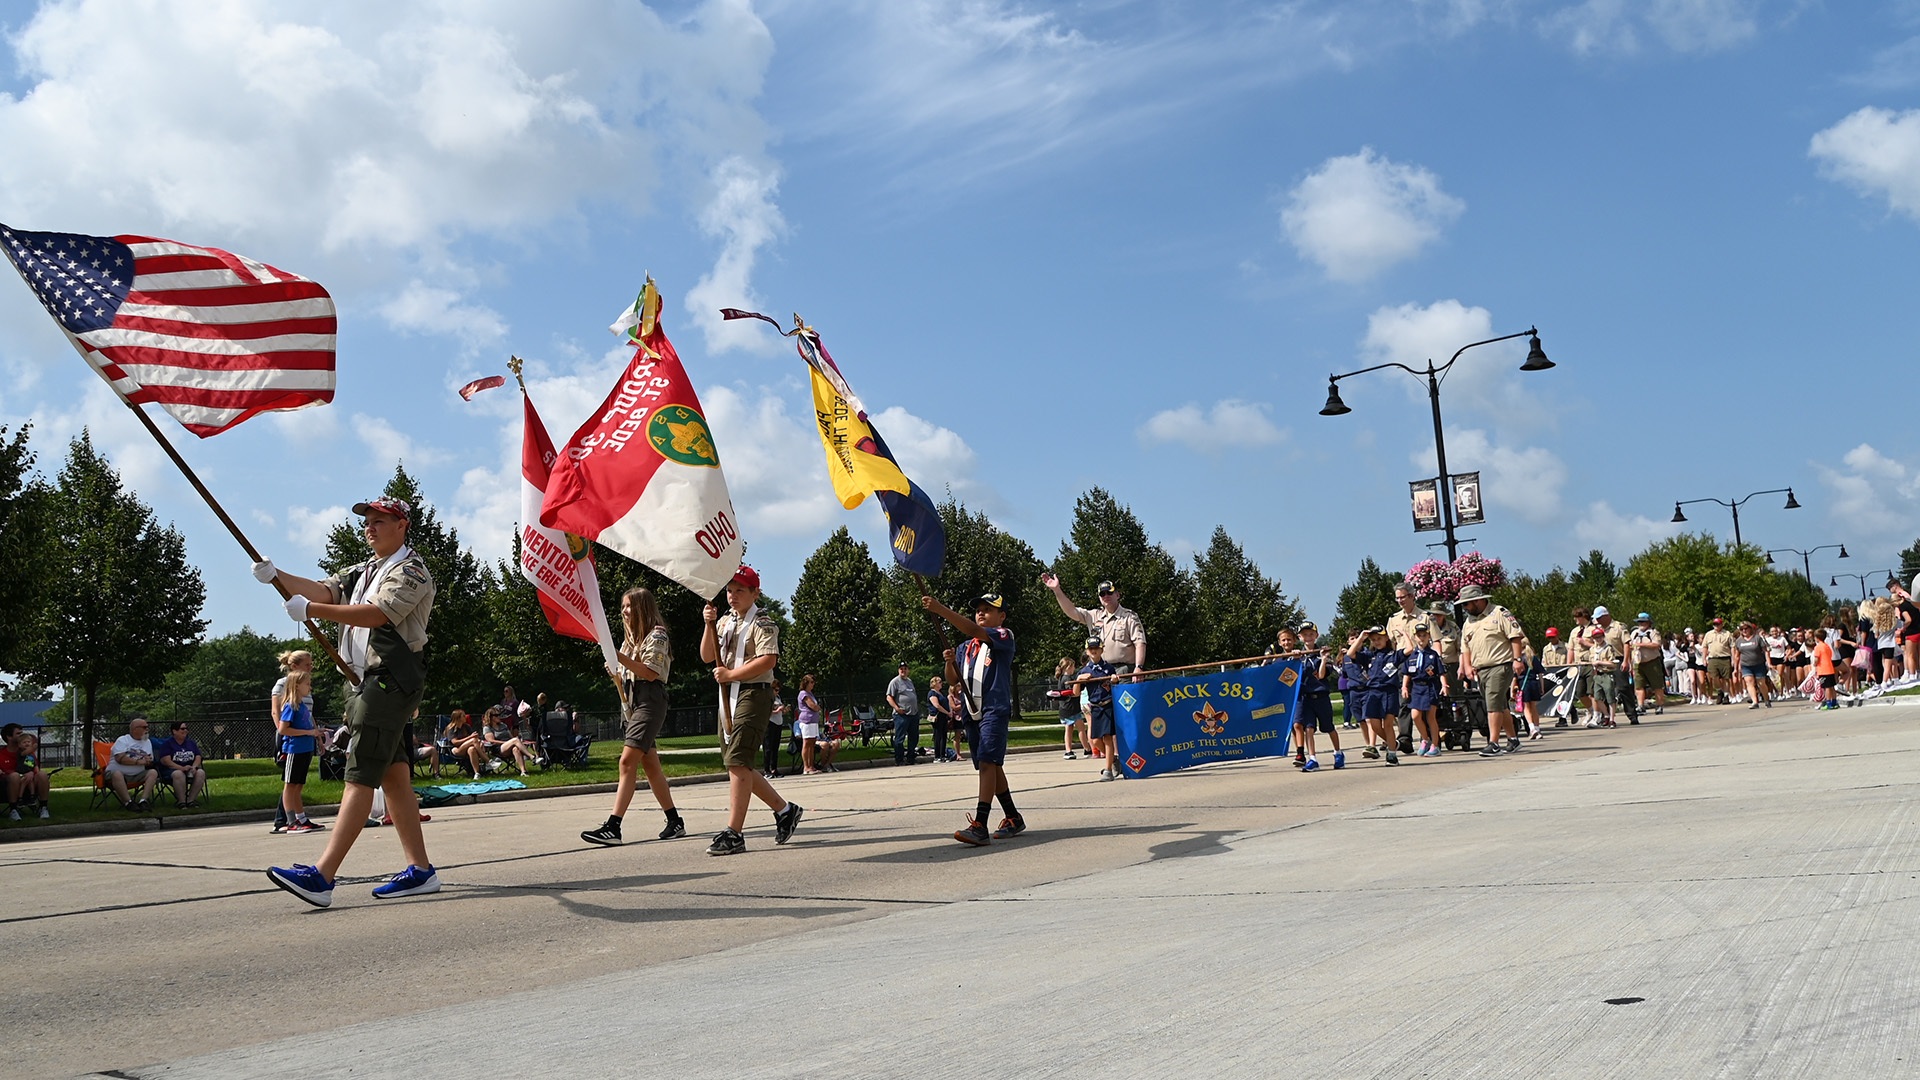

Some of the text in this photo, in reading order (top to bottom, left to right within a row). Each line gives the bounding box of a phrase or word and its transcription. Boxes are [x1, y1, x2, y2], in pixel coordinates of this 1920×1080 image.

[893, 524, 916, 555] OHIO
[522, 524, 577, 585] MENTOR,
[521, 549, 540, 573] AKE
[535, 564, 563, 591] ERIE
[559, 583, 594, 624] COUNC
[1162, 681, 1254, 708] PACK 383
[1154, 731, 1278, 757] ST. BEDE THE VENERABLE
[1224, 748, 1244, 756] OHIO
